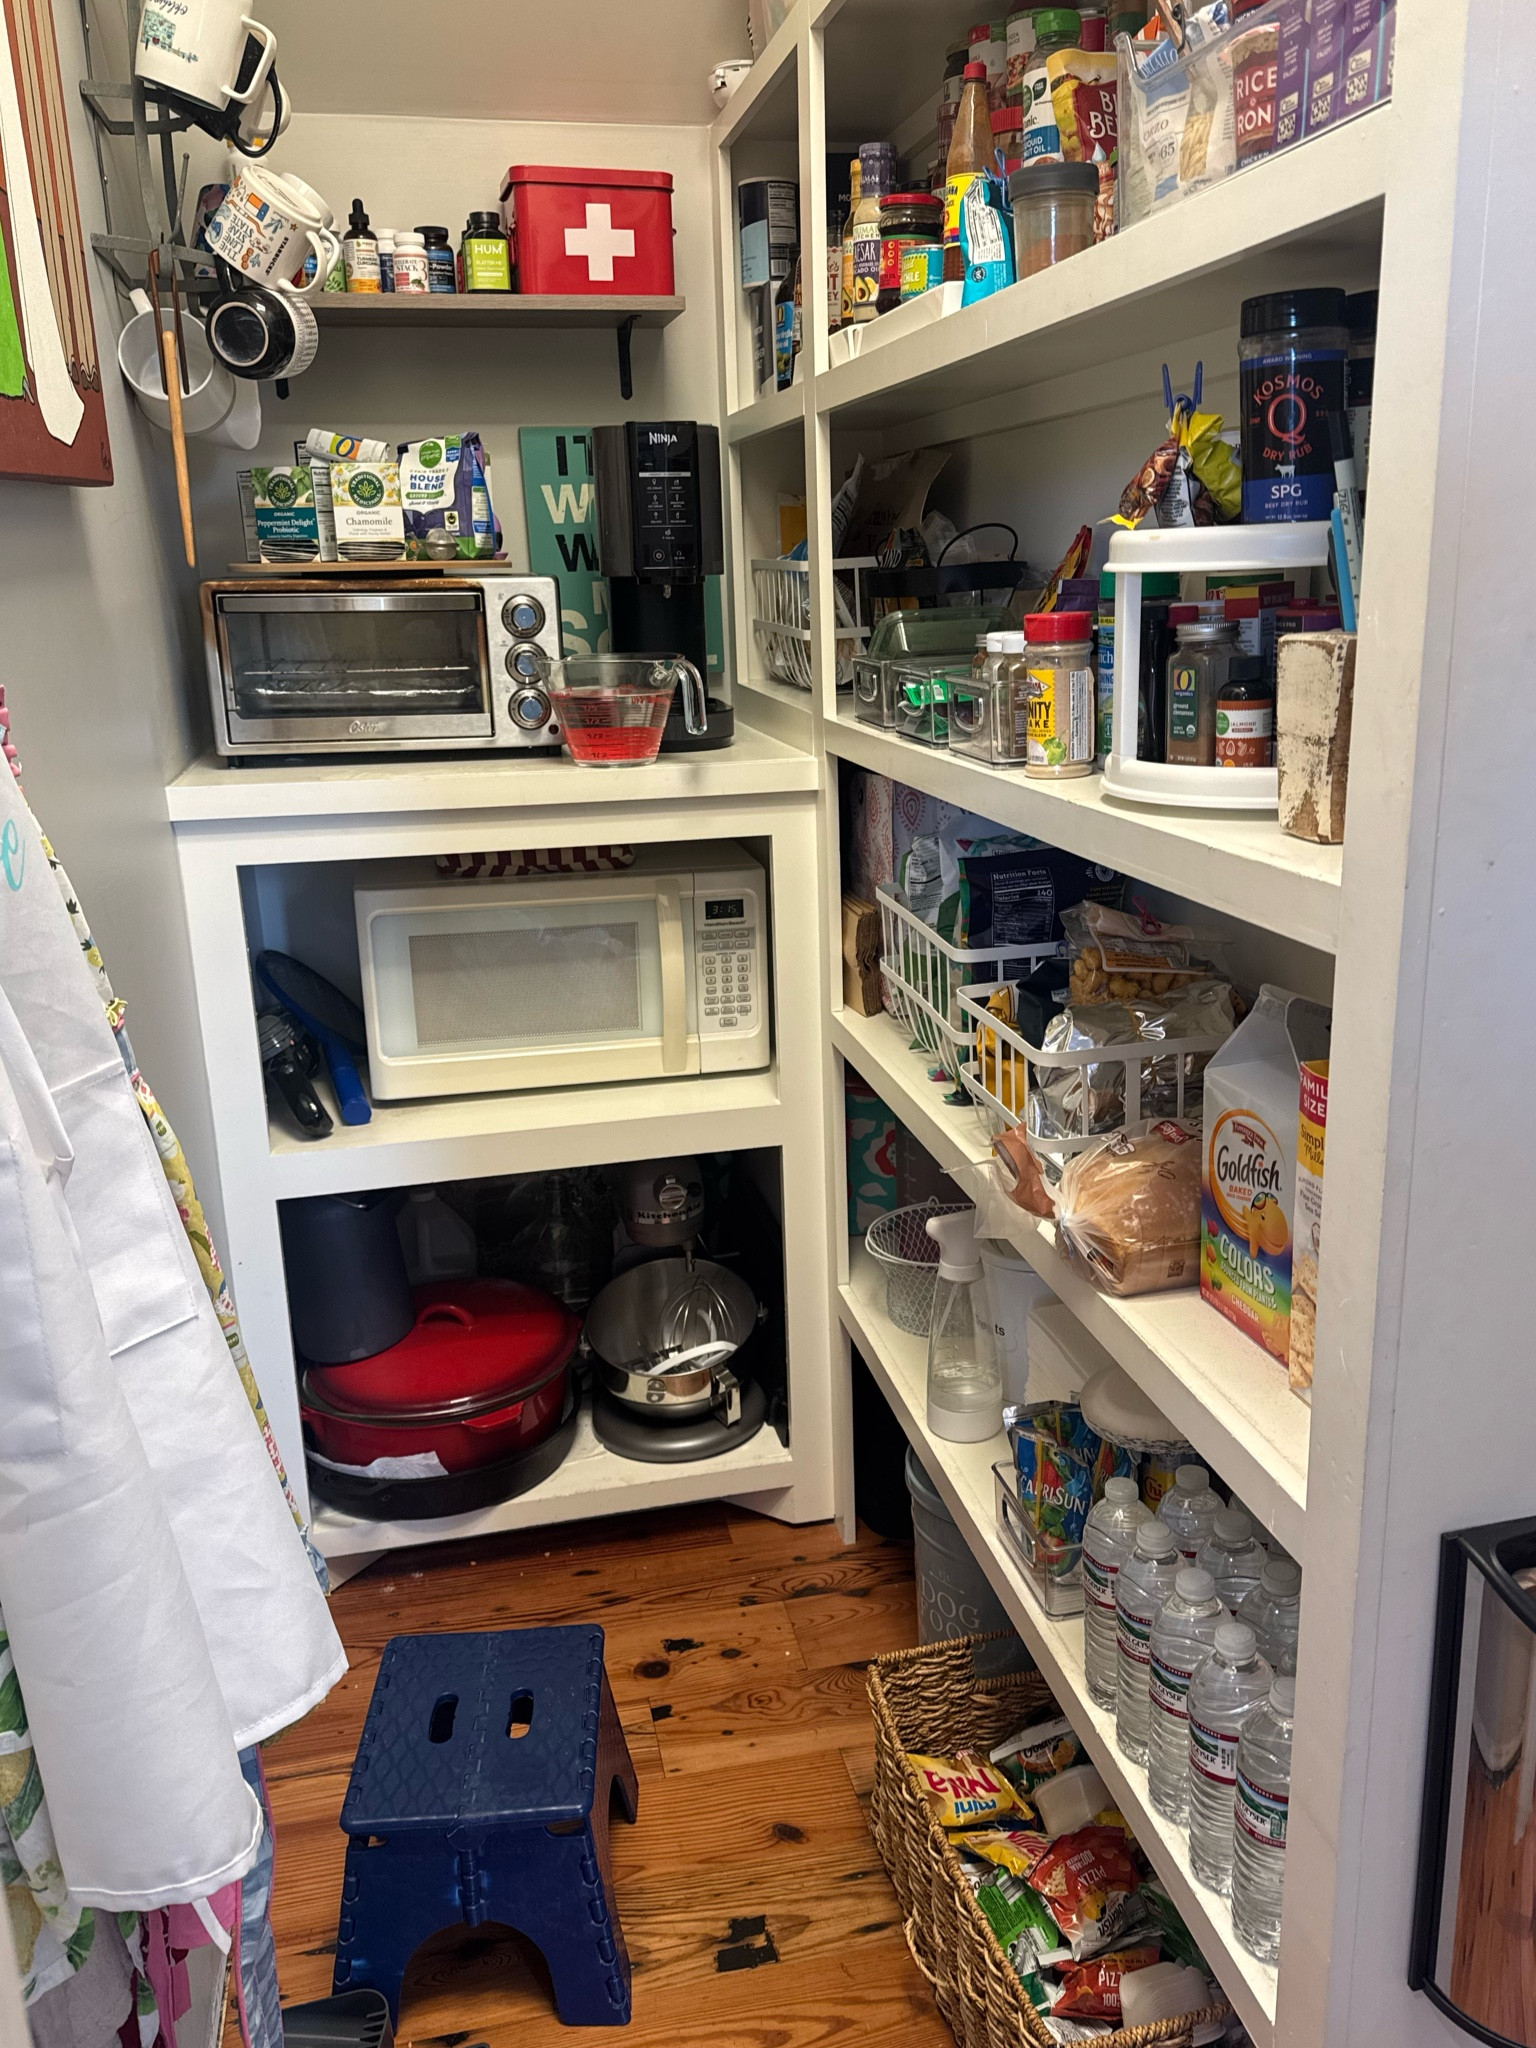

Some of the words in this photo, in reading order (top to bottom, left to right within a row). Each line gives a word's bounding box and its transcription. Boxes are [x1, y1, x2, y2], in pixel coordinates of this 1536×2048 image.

[1236, 66, 1278, 100] RICE
[1237, 104, 1273, 136] RON
[474, 243, 503, 254] HUM
[1253, 373, 1324, 407] KOSMOS
[1267, 393, 1307, 445] Q
[649, 432, 678, 447] NINJA
[1262, 447, 1286, 462] DRY
[1288, 444, 1313, 461] RUB
[410, 474, 446, 482] HOUSE
[410, 482, 444, 490] BLEND
[1270, 483, 1302, 499] SPG
[257, 518, 290, 528] Peppermint
[346, 517, 393, 526] Chamomile
[712, 905, 737, 914] 3:15
[1300, 1072, 1328, 1099] FAMIL
[1303, 1094, 1326, 1118] SIZE
[1301, 1124, 1324, 1151] Simpl
[1217, 1145, 1282, 1191] Goldfish
[1229, 1184, 1252, 1197] BAKED
[638, 1203, 700, 1219] KitchenAid
[1220, 1233, 1276, 1295] COLORS
[921, 1575, 981, 1629] DOG
[954, 1799, 997, 1819] mini
[1077, 1865, 1108, 1888] PIZZA
